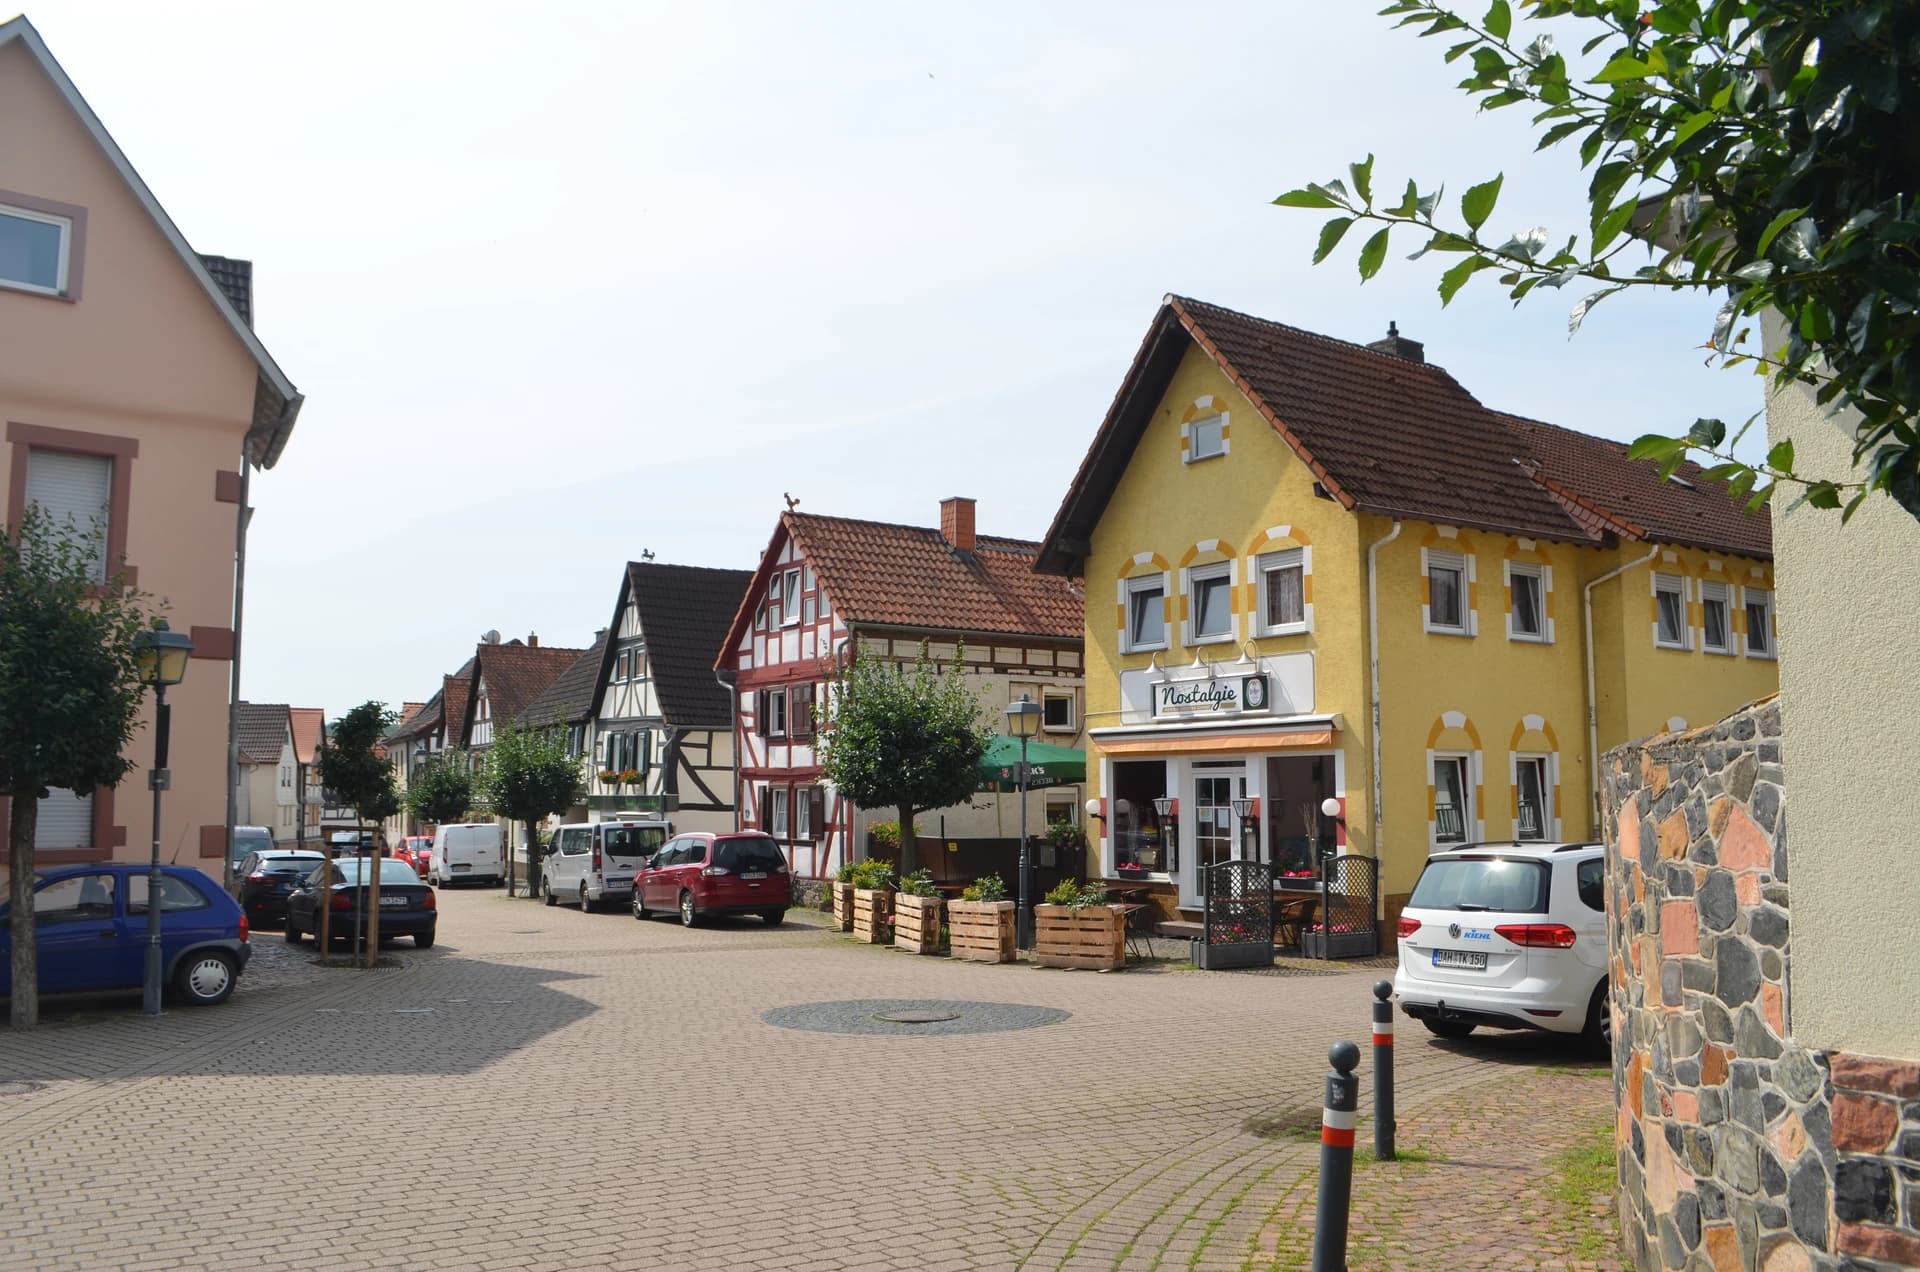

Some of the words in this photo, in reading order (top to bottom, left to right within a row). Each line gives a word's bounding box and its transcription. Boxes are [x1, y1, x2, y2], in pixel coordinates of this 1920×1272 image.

[1162, 681, 1237, 711] Nostalgie
[1438, 951, 1453, 964] DAH
[1458, 953, 1468, 965] TK
[1470, 953, 1485, 966] 150
